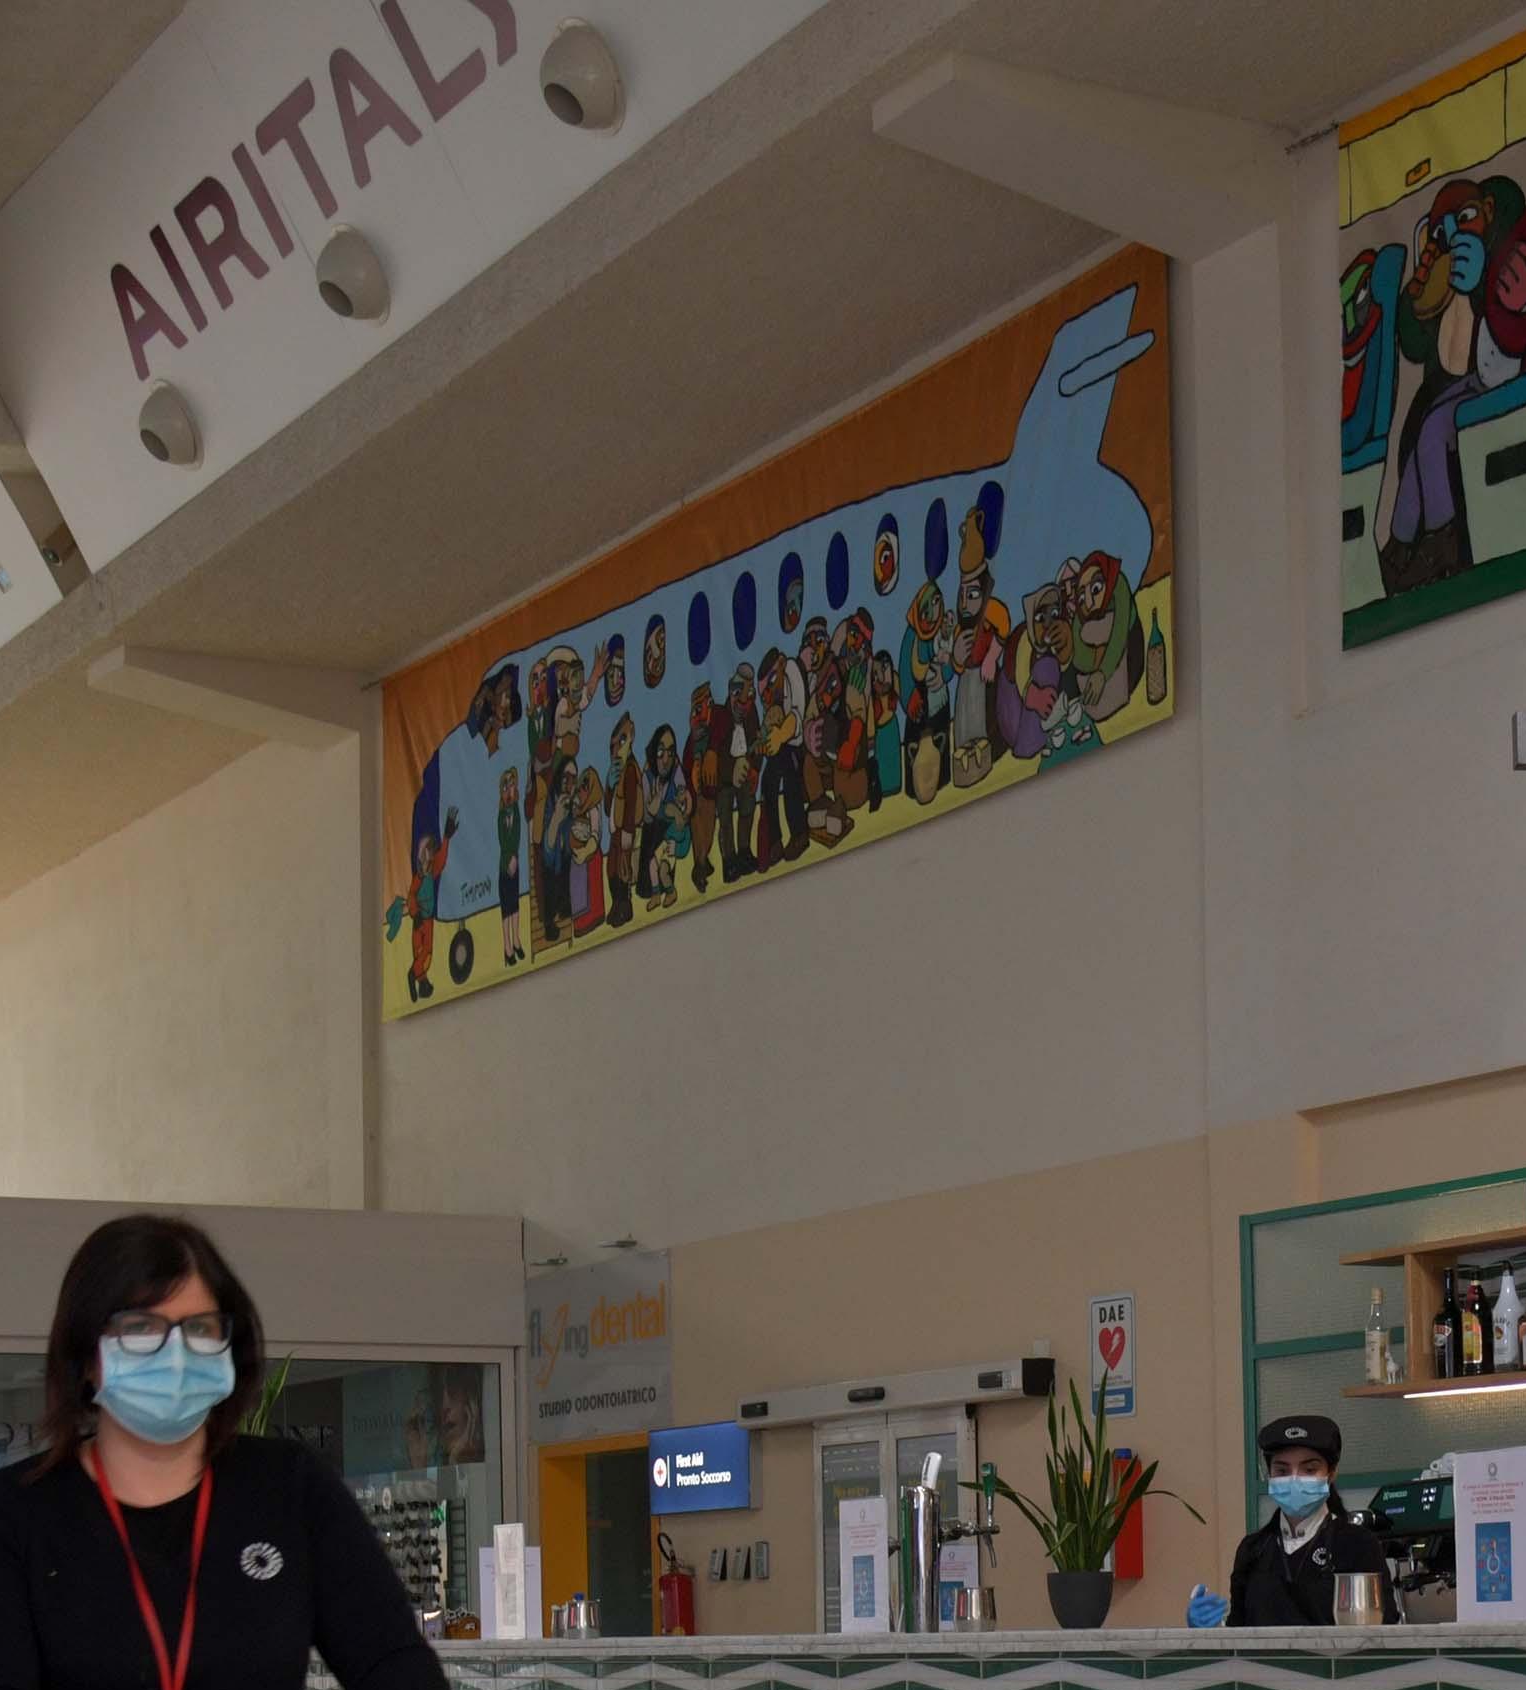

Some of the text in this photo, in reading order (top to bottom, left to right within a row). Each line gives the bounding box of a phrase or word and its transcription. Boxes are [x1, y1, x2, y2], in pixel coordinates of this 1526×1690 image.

[1098, 1304, 1125, 1323] DAE
[539, 1387, 656, 1419] STUDIO ODONTOIATRICO
[676, 1452, 704, 1469] First Aid
[676, 1470, 732, 1486] Pronto Soccorso
